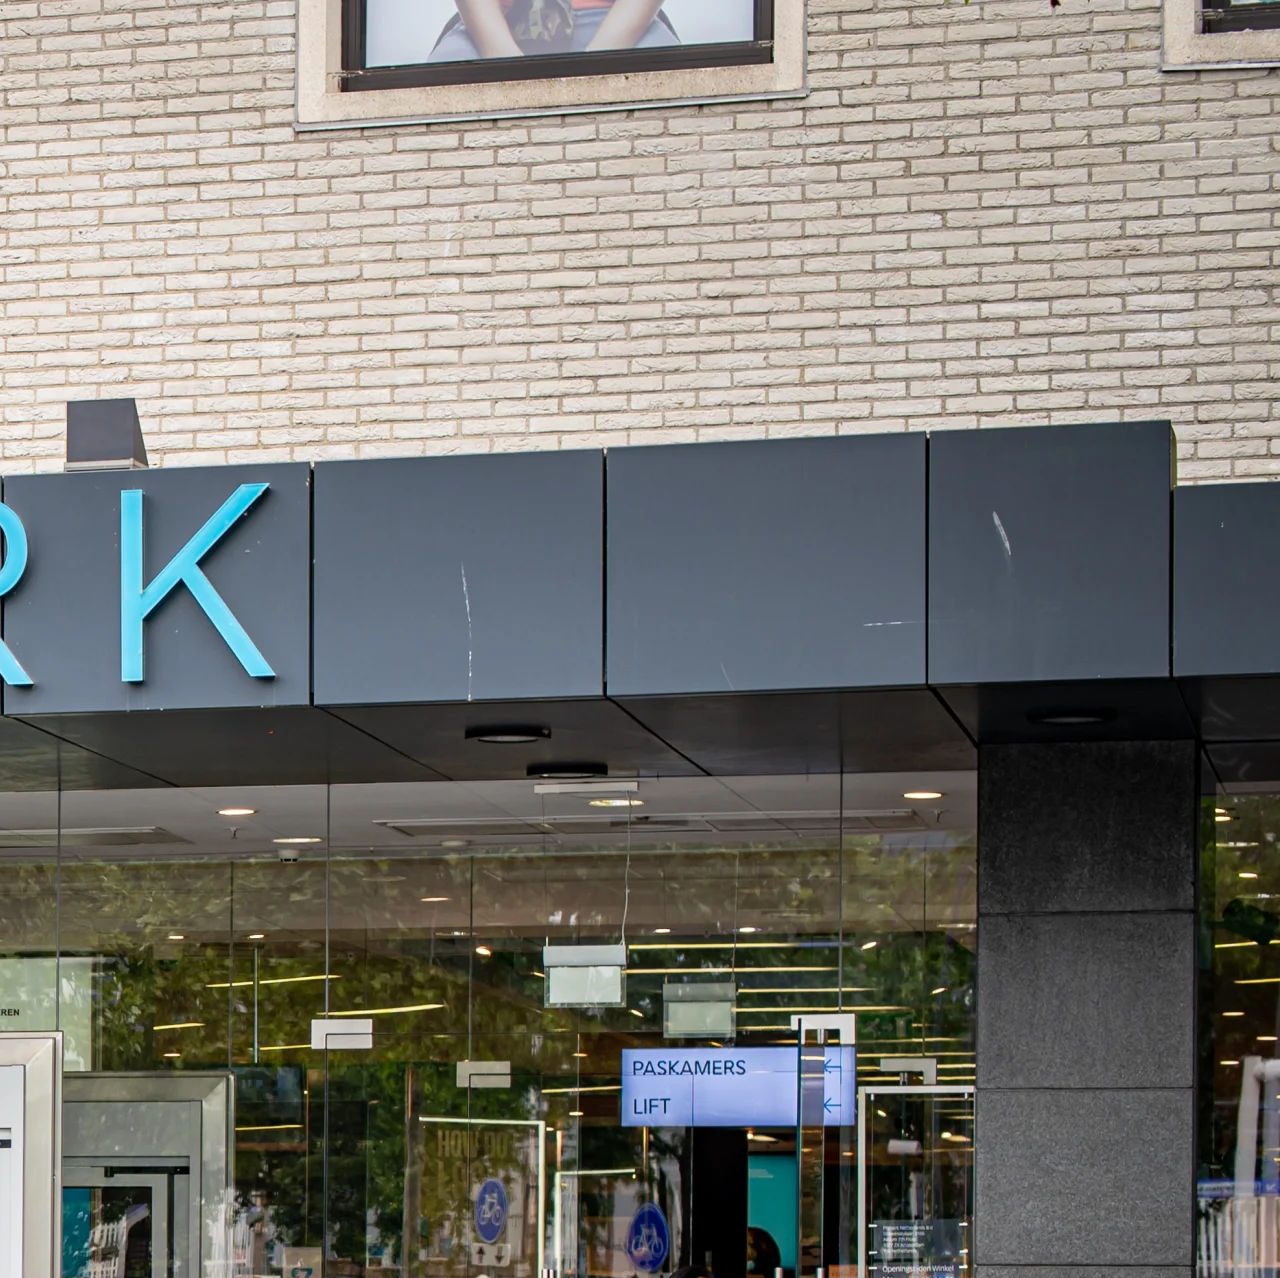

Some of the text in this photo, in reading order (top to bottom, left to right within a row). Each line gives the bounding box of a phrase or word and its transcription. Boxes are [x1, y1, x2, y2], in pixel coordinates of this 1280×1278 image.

[632, 1059, 747, 1076] PASKAMERS
[633, 1098, 671, 1115] LIFT
[437, 1129, 479, 1158] HOW
[932, 1264, 954, 1272] Winkel
